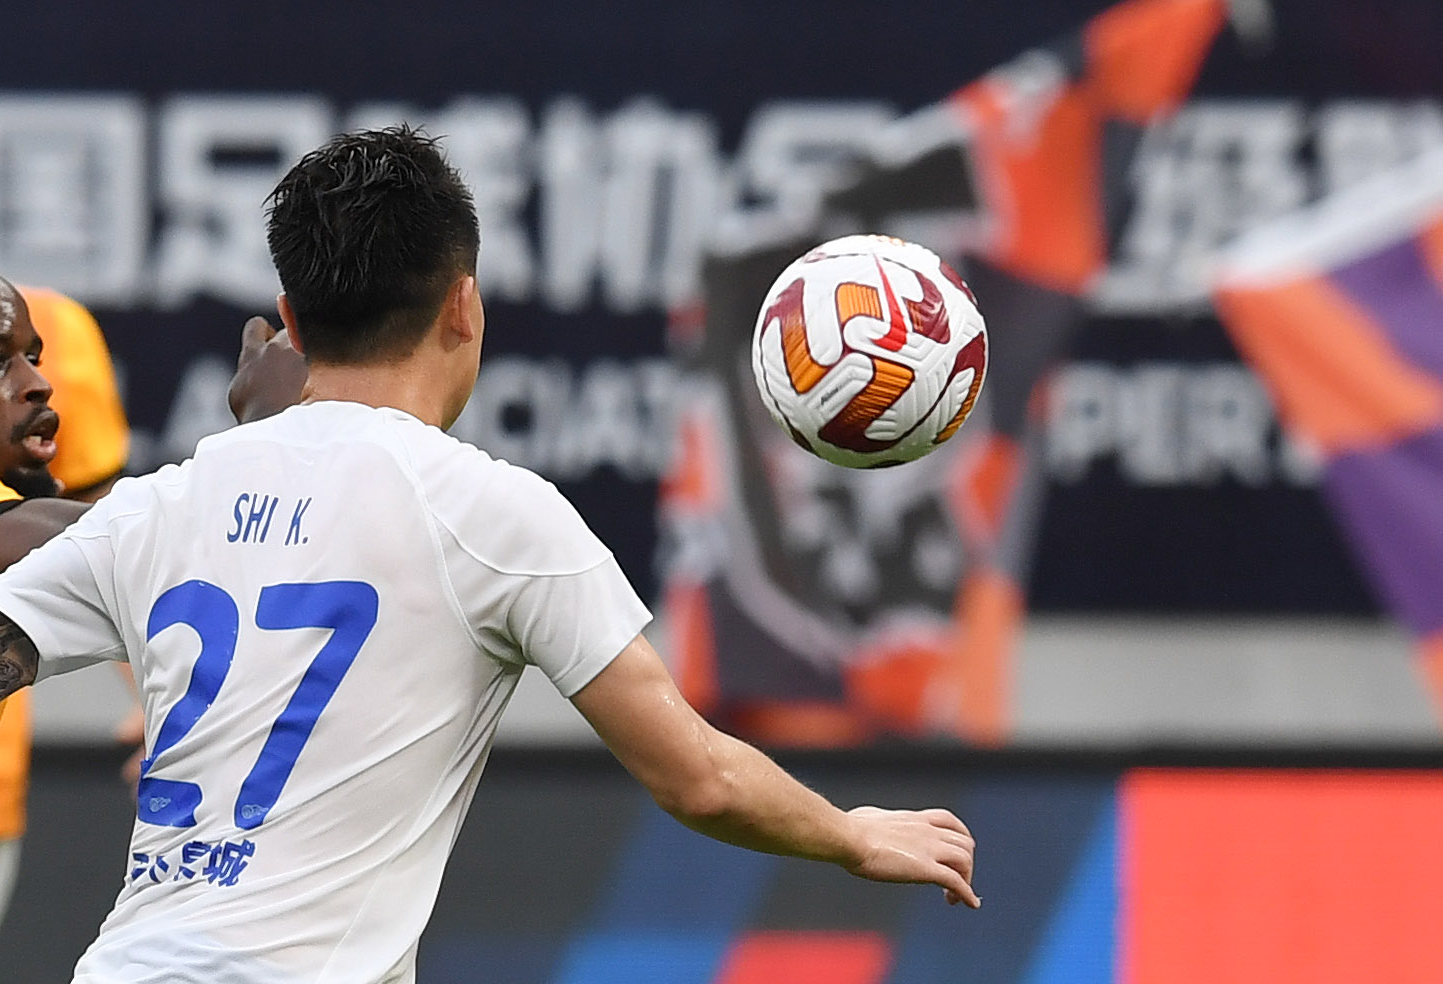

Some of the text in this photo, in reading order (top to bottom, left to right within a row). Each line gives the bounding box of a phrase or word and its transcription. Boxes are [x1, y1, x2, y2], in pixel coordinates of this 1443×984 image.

[227, 492, 313, 546] SHI K.
[138, 579, 379, 831] 27
